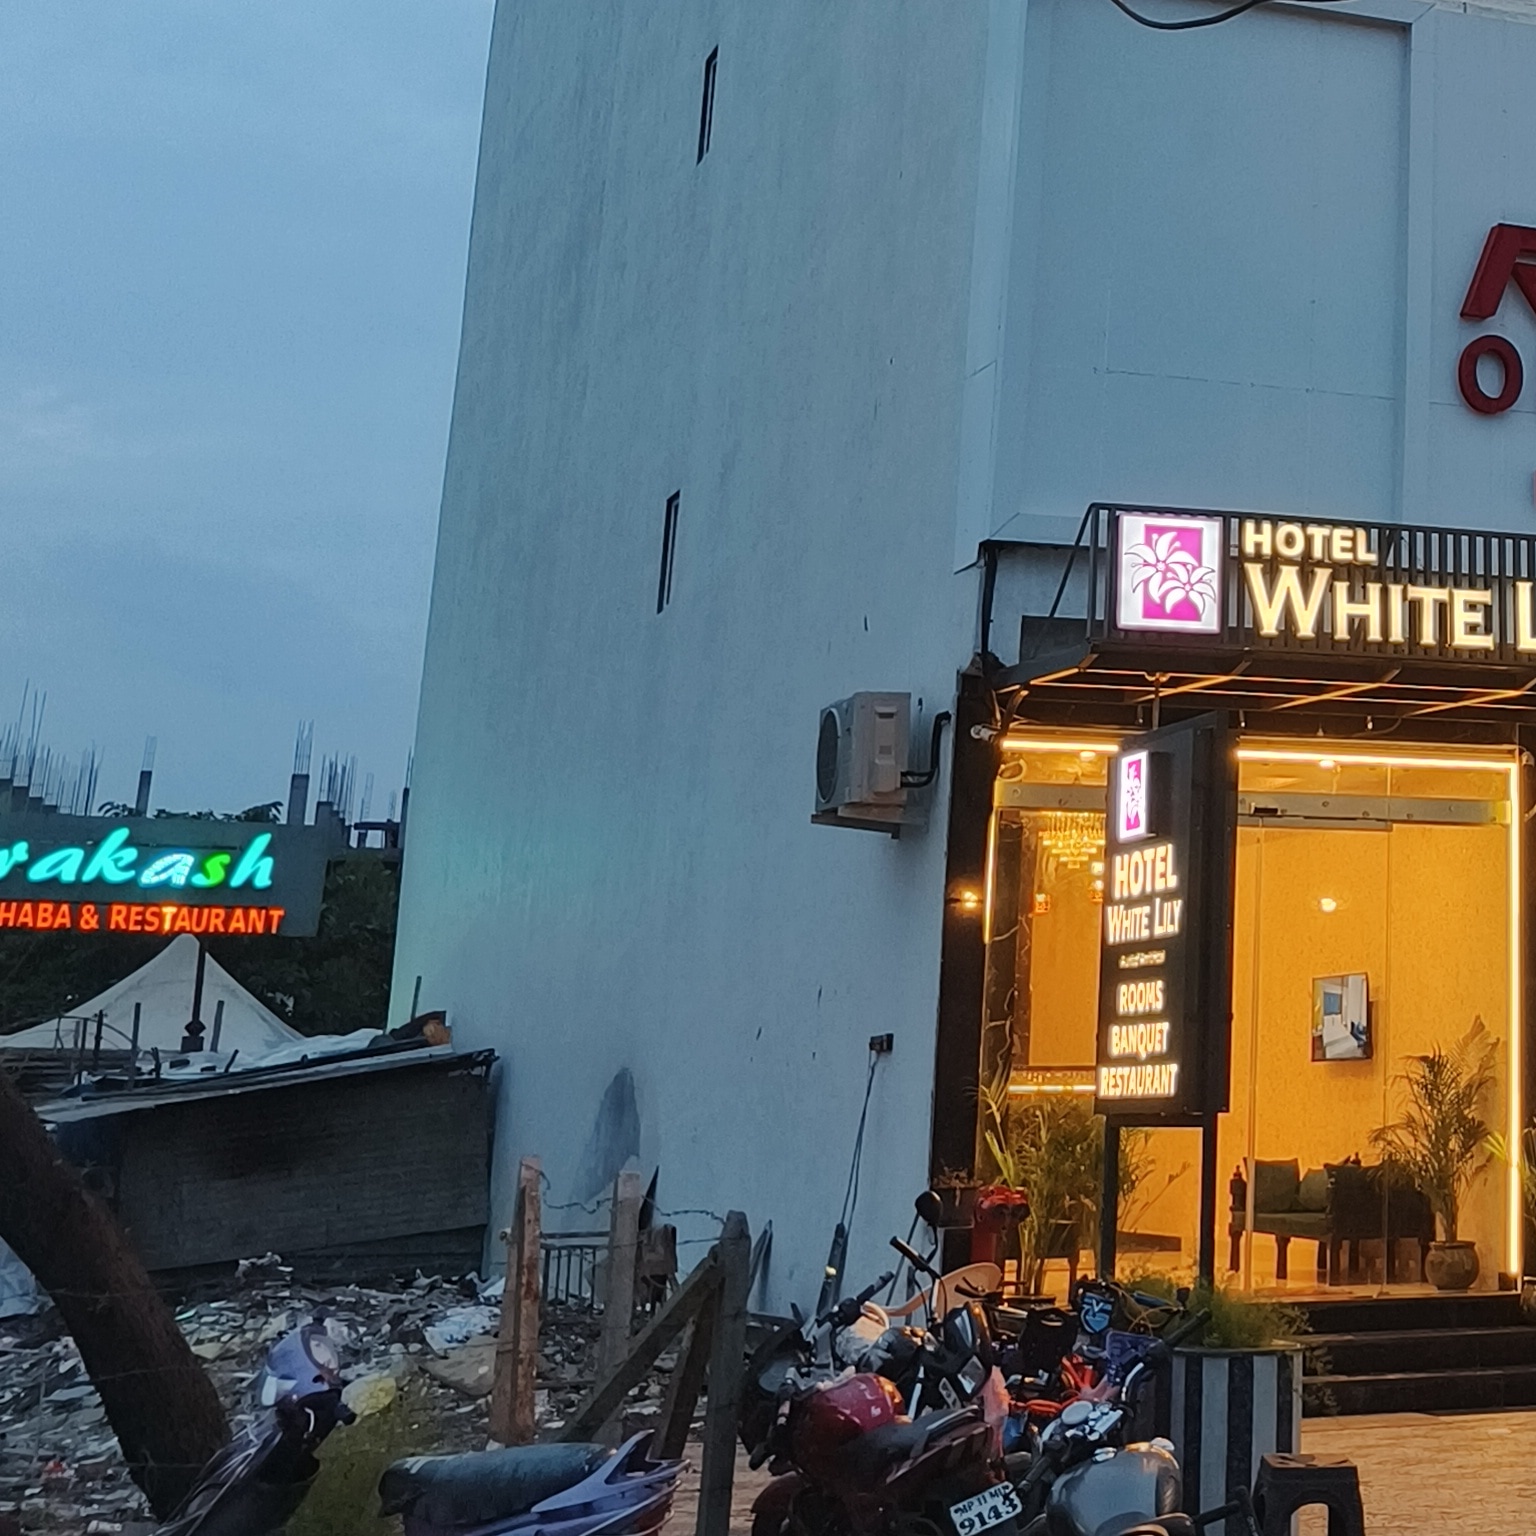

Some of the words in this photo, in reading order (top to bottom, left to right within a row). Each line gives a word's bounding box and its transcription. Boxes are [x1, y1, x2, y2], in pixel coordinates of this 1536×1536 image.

[1242, 520, 1378, 564] HOTEL
[1243, 562, 1495, 651] WHITE
[1113, 844, 1178, 900] HOTEL
[79, 904, 99, 930] &
[109, 903, 286, 935] RESTAURANT
[1106, 904, 1150, 945] WHITE
[1154, 898, 1182, 936] LILY
[1118, 980, 1164, 1014] ROOMS
[1110, 1021, 1170, 1060] BANQUET
[1100, 1064, 1178, 1097] RESTAURANT
[958, 1497, 1019, 1535] 9143
